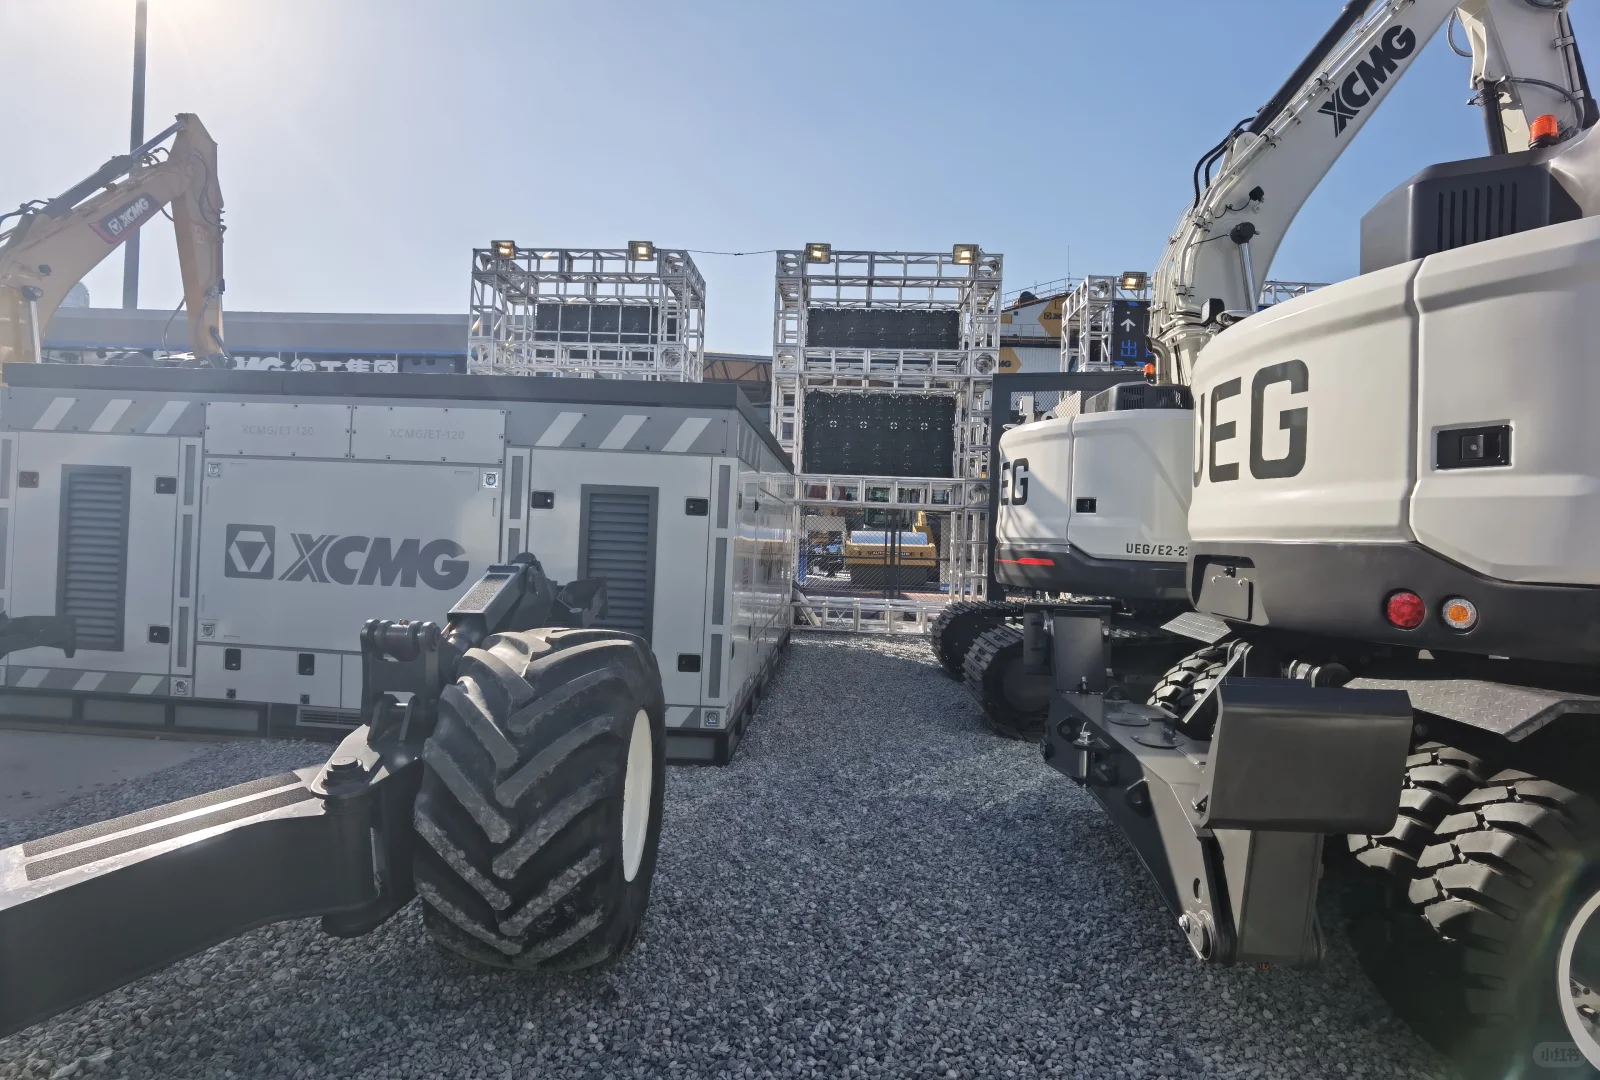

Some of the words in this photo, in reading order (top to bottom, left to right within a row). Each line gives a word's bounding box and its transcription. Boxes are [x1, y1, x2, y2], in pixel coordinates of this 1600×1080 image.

[1317, 24, 1416, 138] XCMG
[118, 197, 149, 228] XCMG
[241, 424, 314, 437] XCMG/ET-120
[389, 427, 466, 440] XCMG/ET-120
[1126, 543, 1188, 556] UEG/E2-2
[279, 532, 470, 591] XCMG
